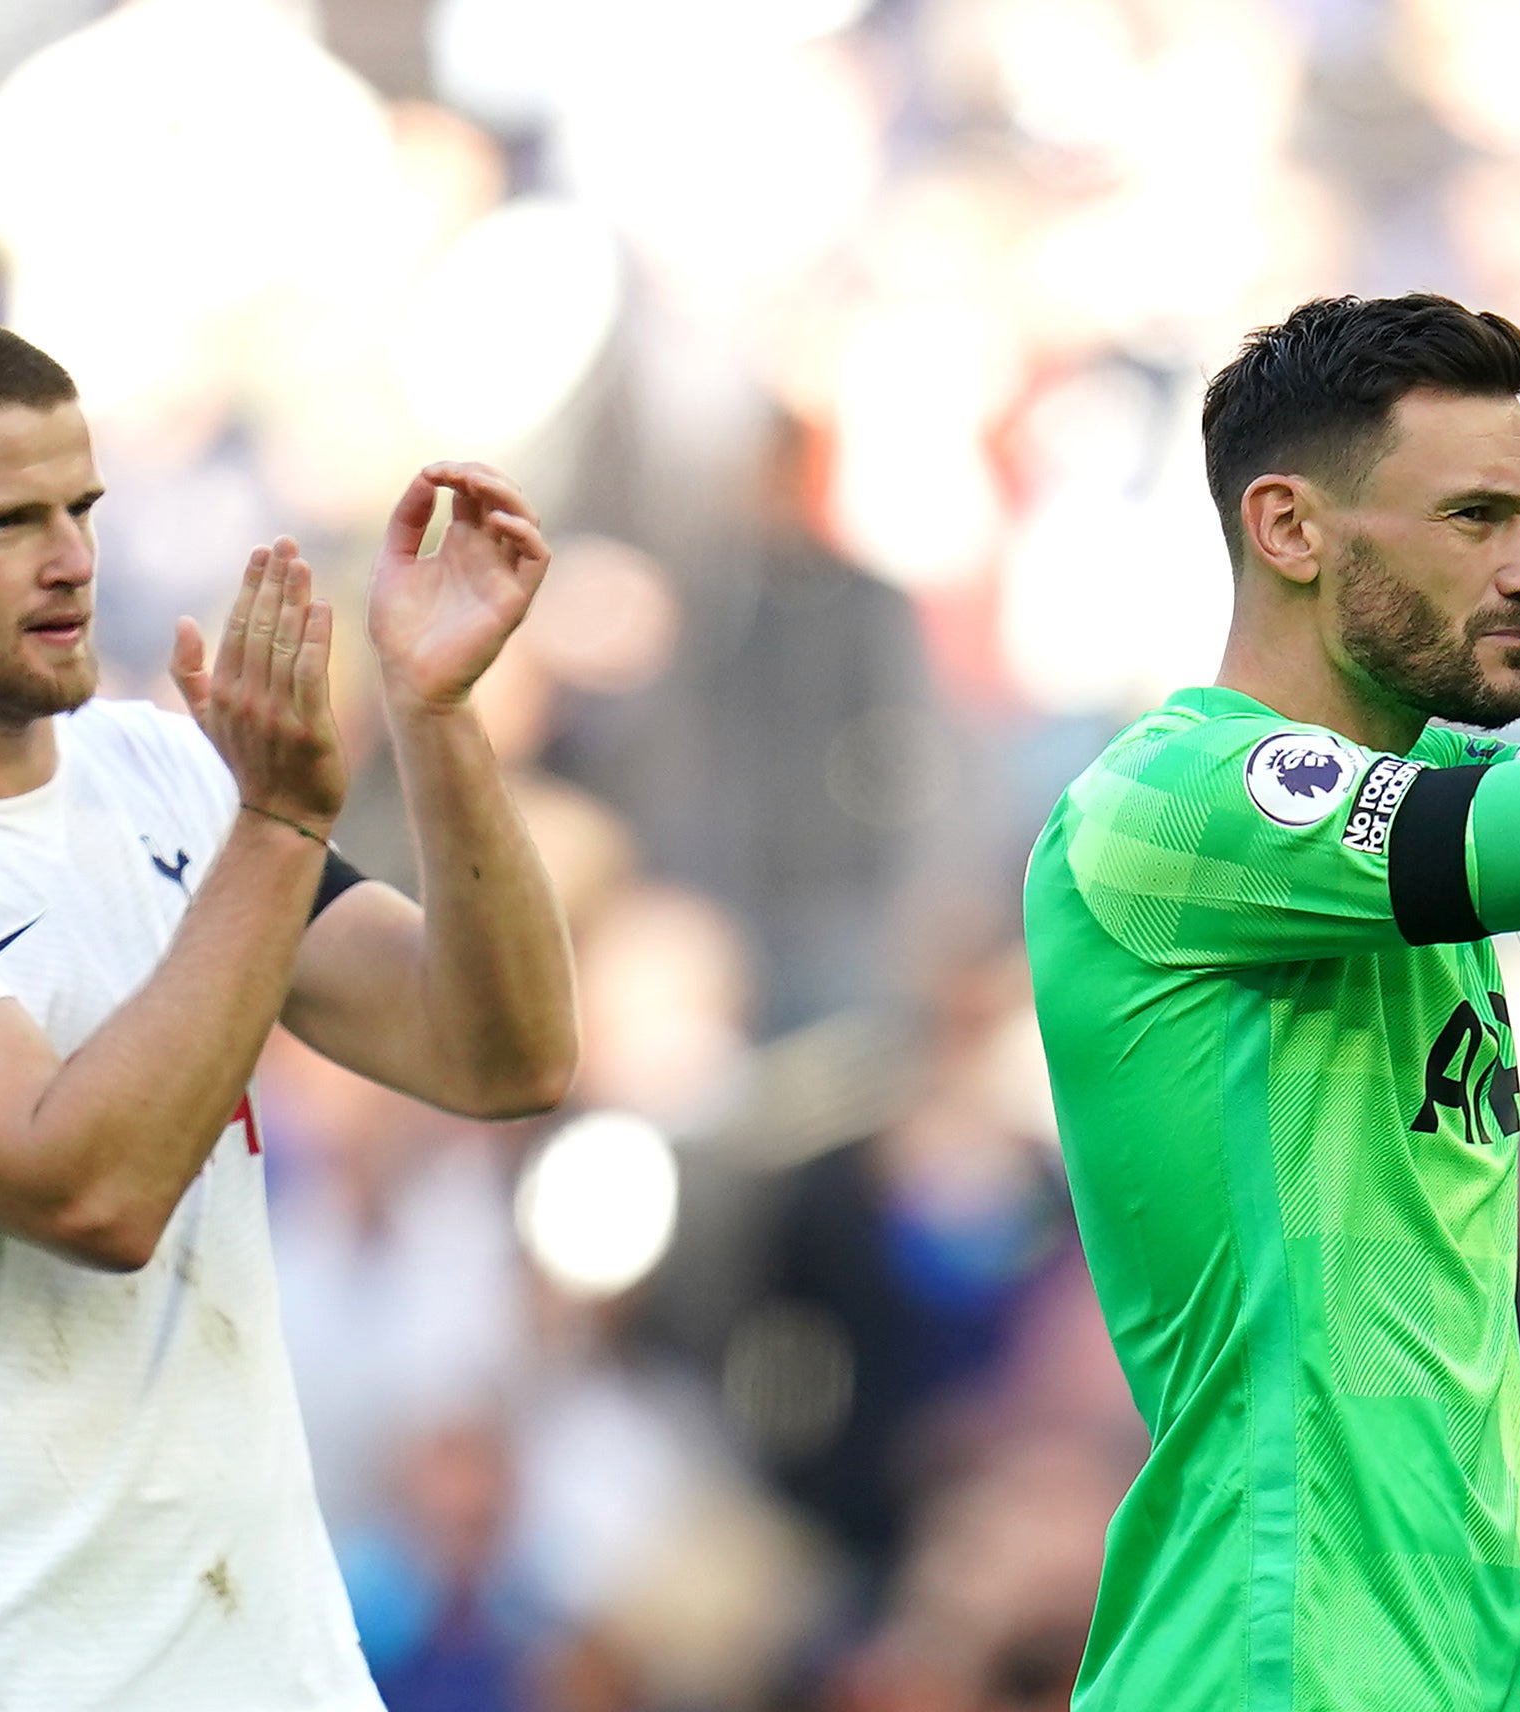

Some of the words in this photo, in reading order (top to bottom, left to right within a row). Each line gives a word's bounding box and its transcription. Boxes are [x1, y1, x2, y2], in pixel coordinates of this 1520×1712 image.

[1341, 812, 1371, 852] No
[1358, 760, 1404, 810] room
[1376, 761, 1422, 814] racism
